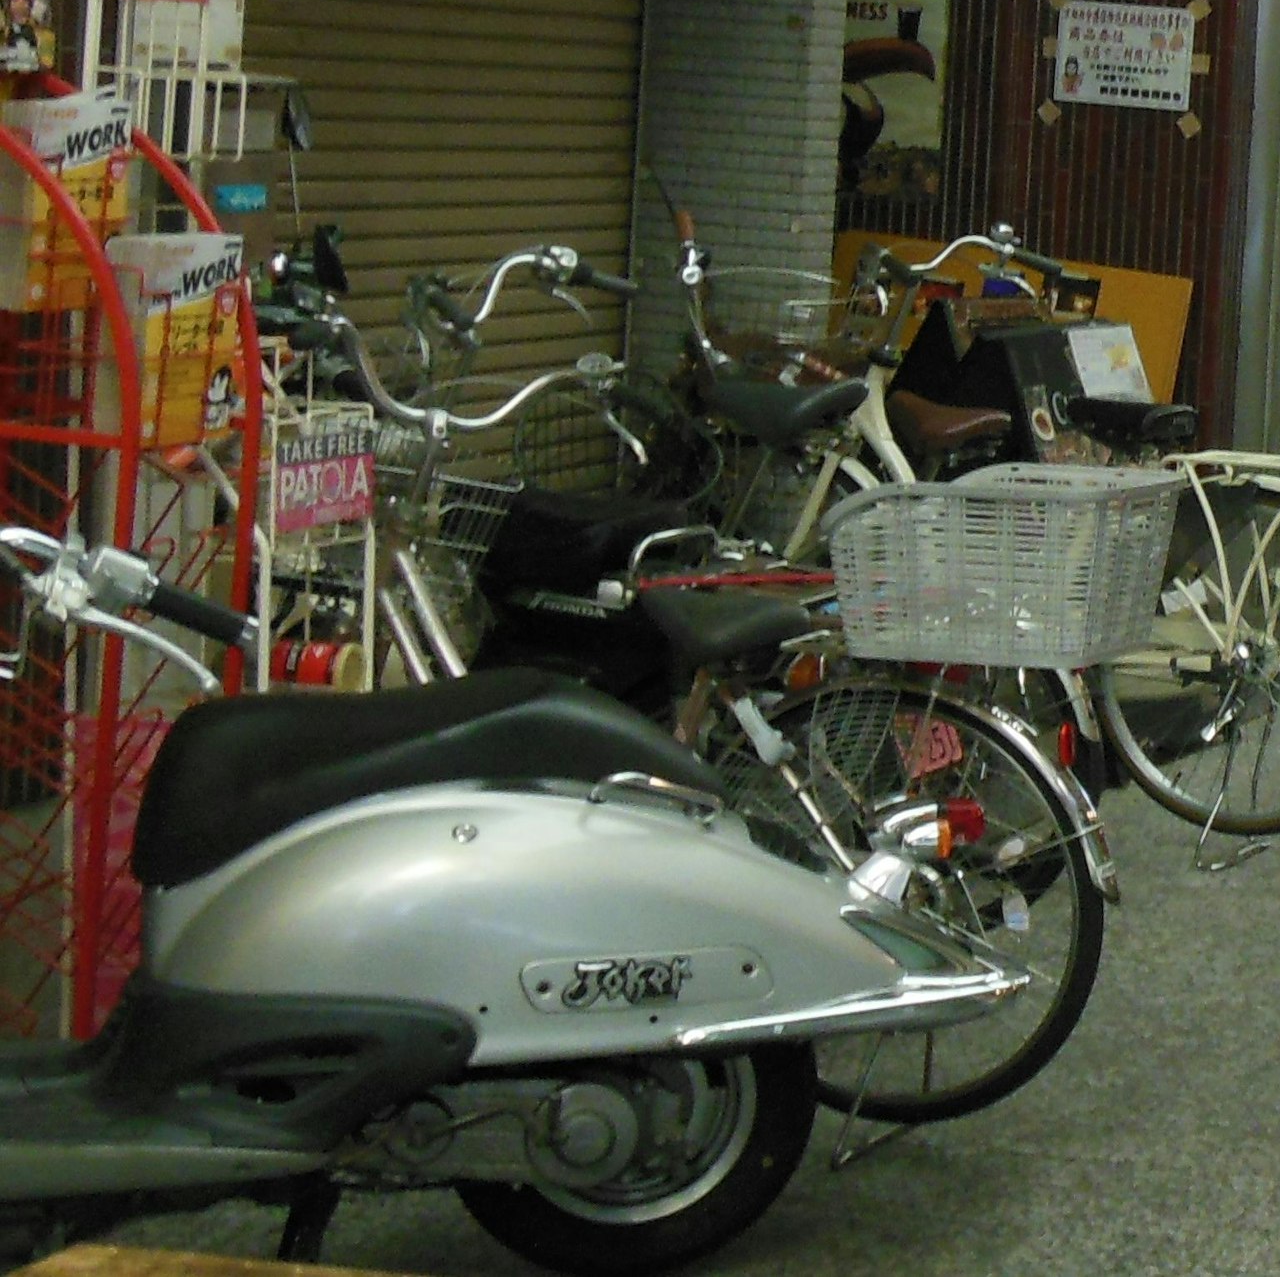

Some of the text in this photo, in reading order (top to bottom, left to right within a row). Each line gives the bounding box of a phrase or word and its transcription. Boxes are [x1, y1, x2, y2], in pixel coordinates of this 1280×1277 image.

[66, 117, 128, 160] WORK
[182, 252, 240, 297] WORK
[280, 425, 370, 464] TAKE FREE
[280, 456, 371, 511] PATOLA
[561, 955, 693, 1009] Joker
